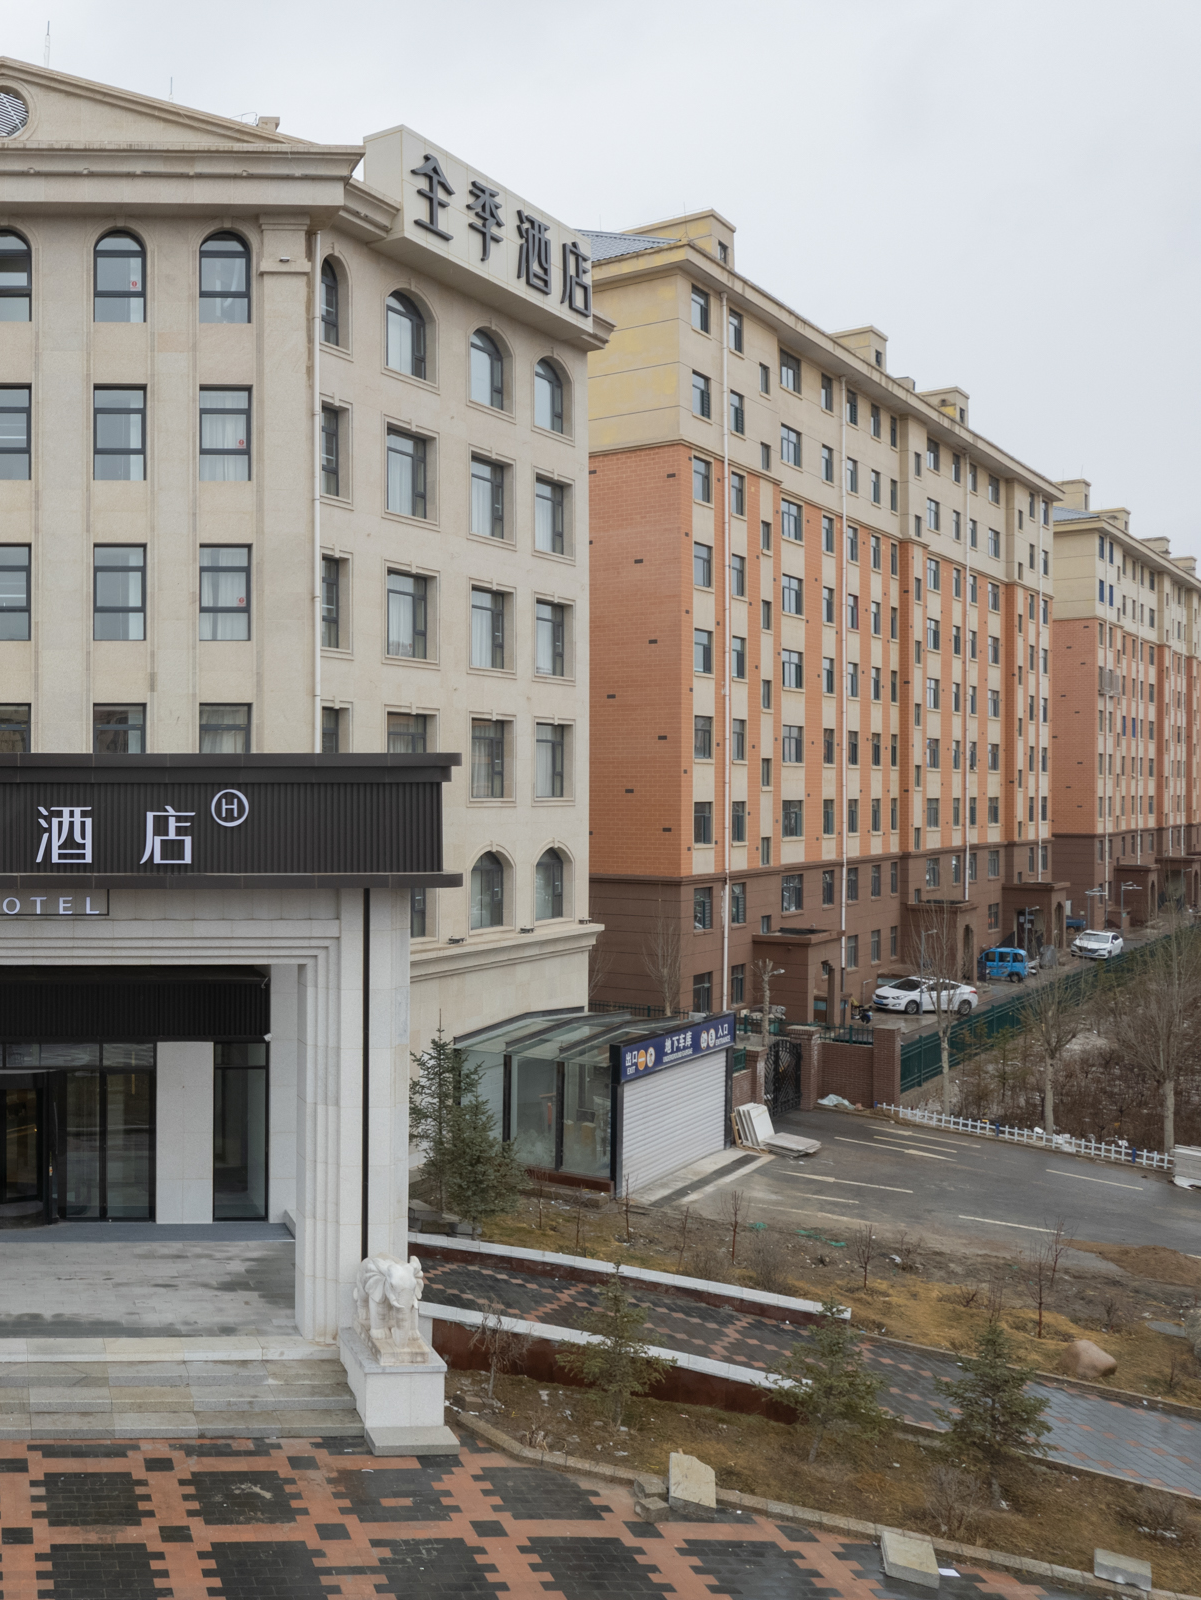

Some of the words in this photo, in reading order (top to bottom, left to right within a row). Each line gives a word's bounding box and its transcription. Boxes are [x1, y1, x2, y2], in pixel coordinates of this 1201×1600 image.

[410, 153, 591, 317] 全季酒店
[717, 1023, 729, 1037] 入口
[664, 1031, 692, 1054] 地下车库
[625, 1051, 638, 1066] 出口
